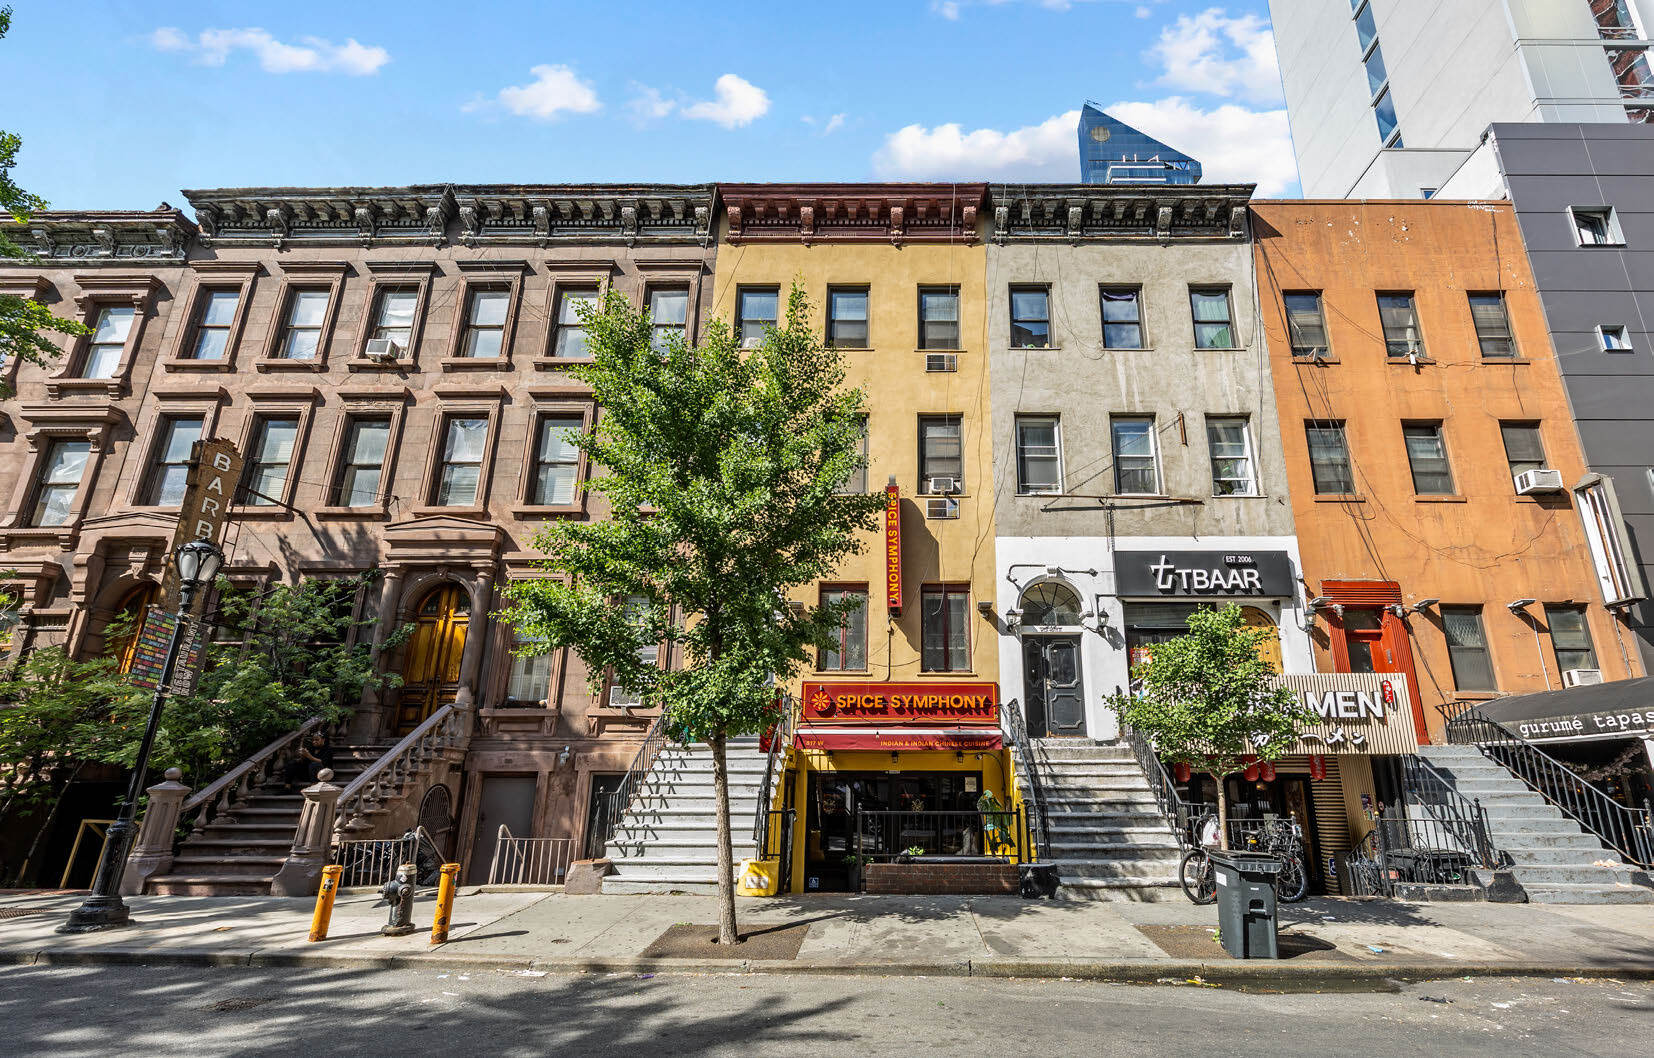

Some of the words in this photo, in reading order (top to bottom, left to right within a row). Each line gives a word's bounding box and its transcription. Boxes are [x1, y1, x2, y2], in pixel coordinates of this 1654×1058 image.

[888, 492, 898, 526] SPICE
[888, 529, 900, 601] SYMPHONY
[1175, 569, 1262, 589] TBAAR
[837, 695, 884, 709] SPICE
[890, 695, 988, 709] SYMPHONY
[1519, 715, 1583, 738] gurumé
[1593, 711, 1654, 730] tapas
